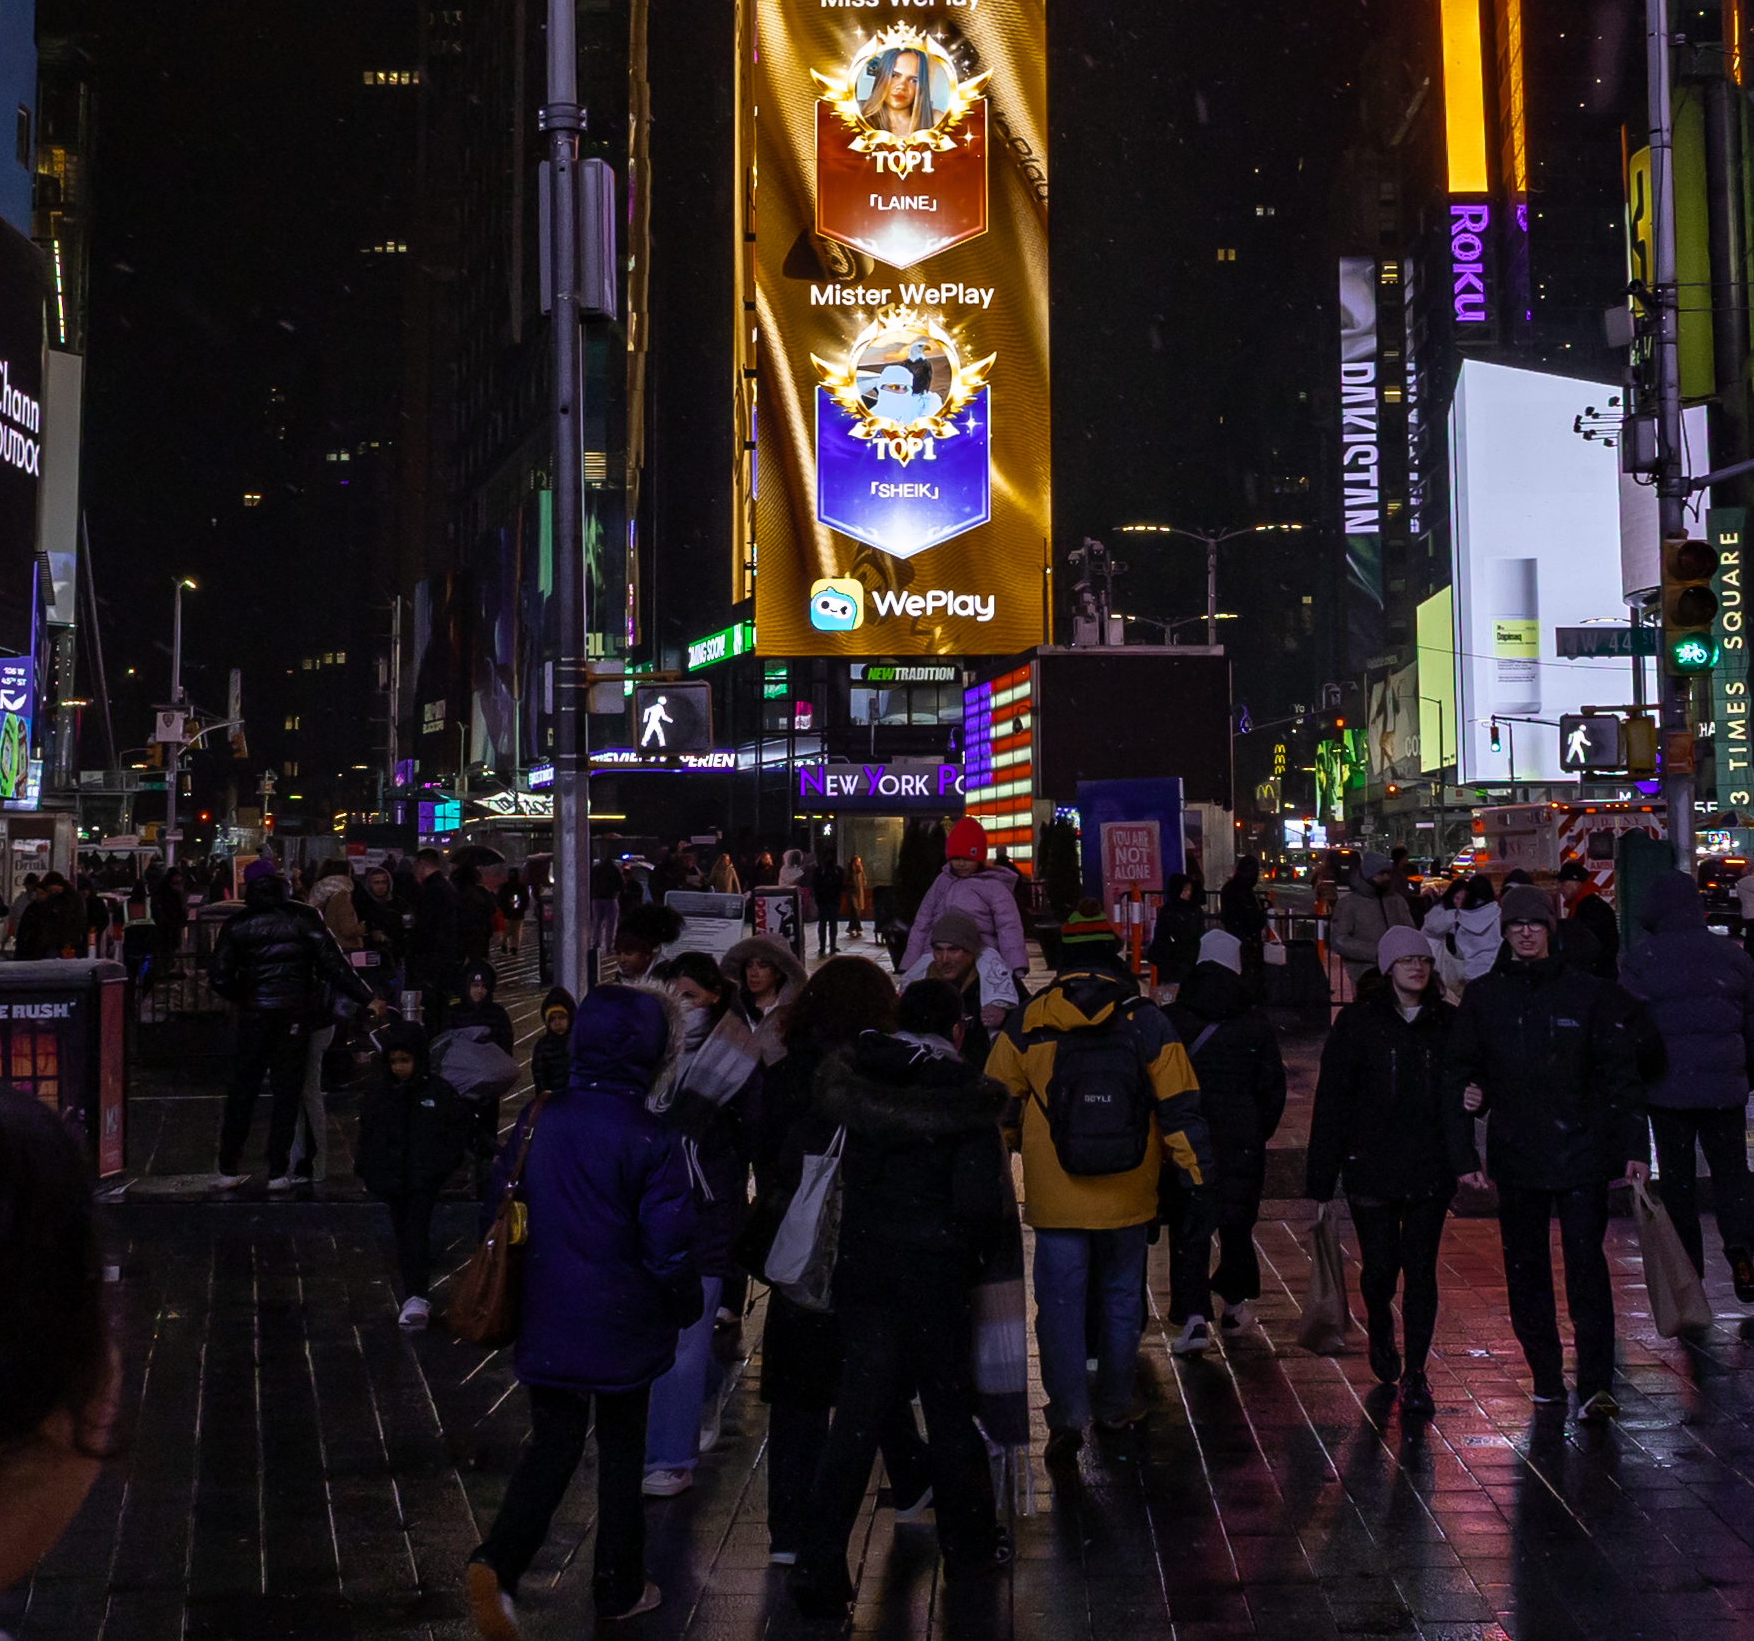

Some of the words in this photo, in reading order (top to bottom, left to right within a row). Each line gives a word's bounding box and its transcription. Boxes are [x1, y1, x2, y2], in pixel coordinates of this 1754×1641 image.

[871, 150, 935, 173] TOP1
[1450, 205, 1489, 322] ROKU
[810, 283, 891, 305] Mister
[899, 282, 995, 308] WePlay
[872, 437, 937, 460] TOP1
[1719, 531, 1742, 649] SQUARE
[871, 590, 995, 622] WePlay
[1582, 633, 1597, 653] W
[1608, 631, 1632, 653] 44
[1725, 681, 1750, 771] TIMES
[799, 765, 859, 796] NEW
[863, 765, 930, 796] YORK
[1730, 790, 1750, 805] 3
[1115, 847, 1150, 865] NOT
[1114, 864, 1151, 880] ALONE
